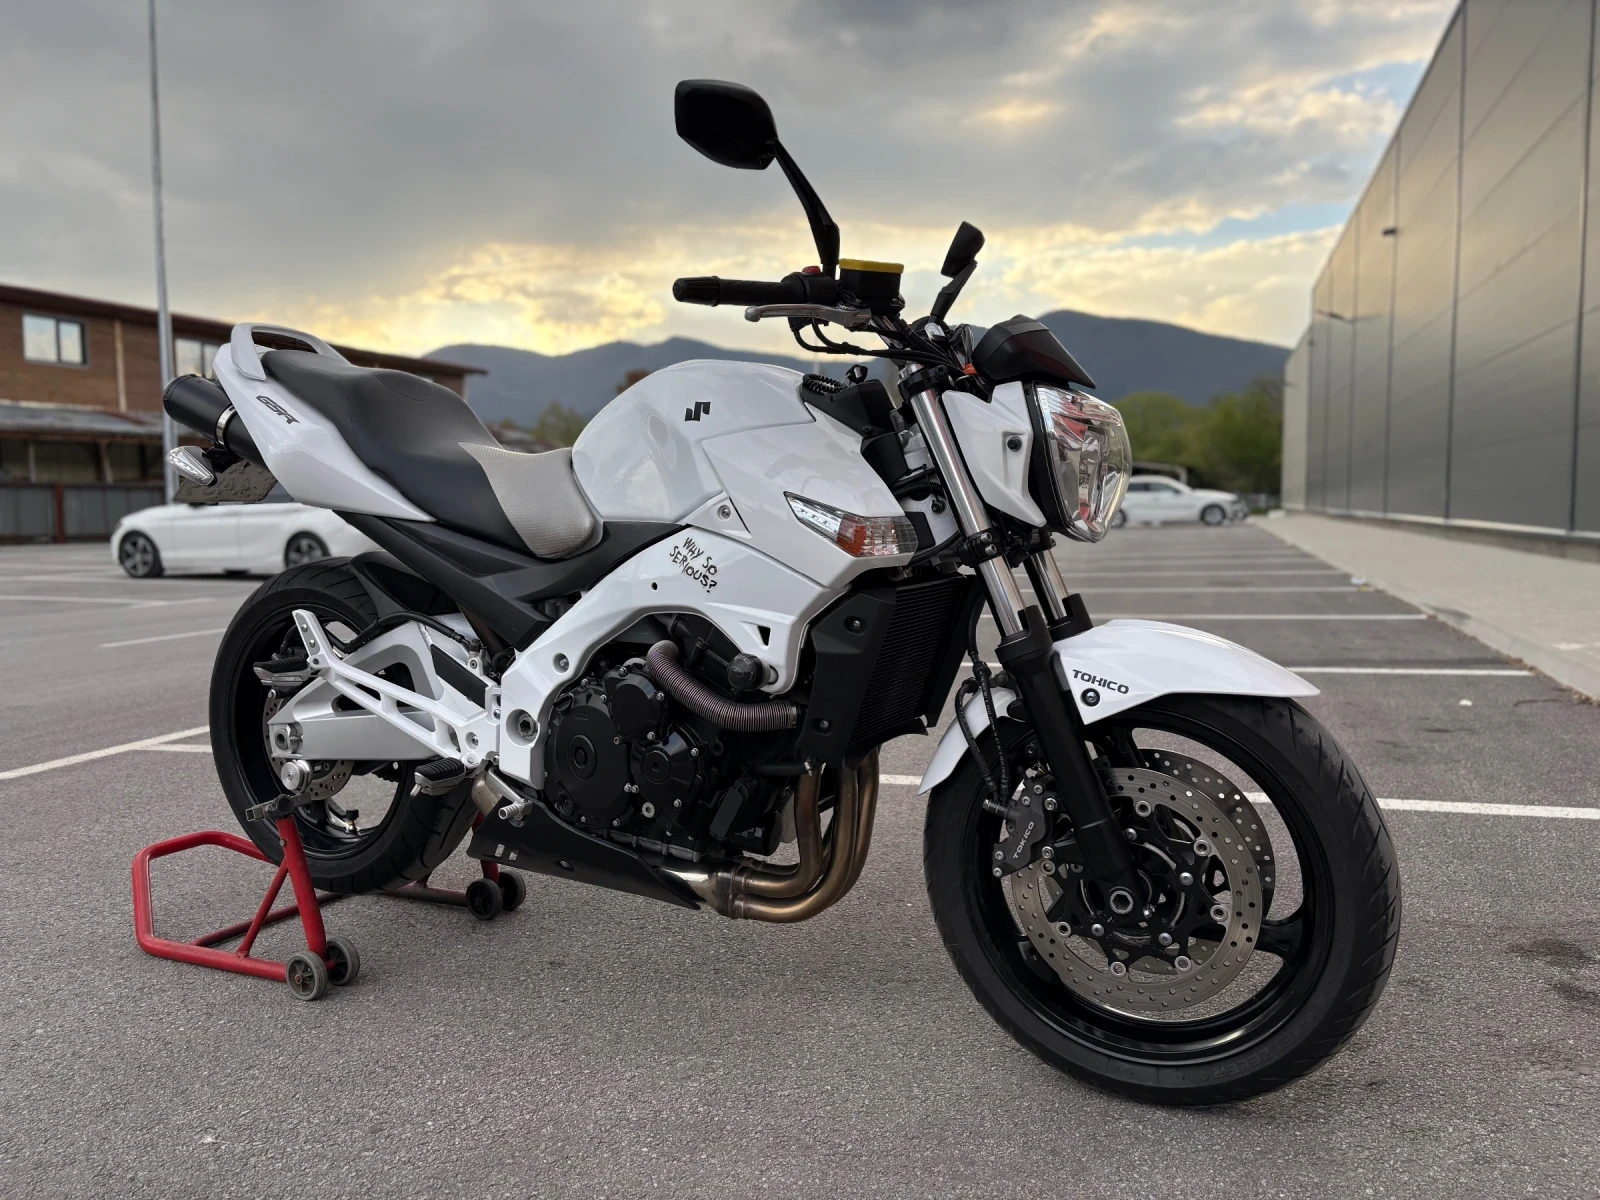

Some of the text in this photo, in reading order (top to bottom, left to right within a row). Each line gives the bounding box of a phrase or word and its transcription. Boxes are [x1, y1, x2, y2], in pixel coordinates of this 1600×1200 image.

[255, 395, 300, 424] GSR
[669, 545, 717, 593] SERIOUS?
[682, 536, 717, 575] WHY SO
[1012, 821, 1034, 858] TOKICO
